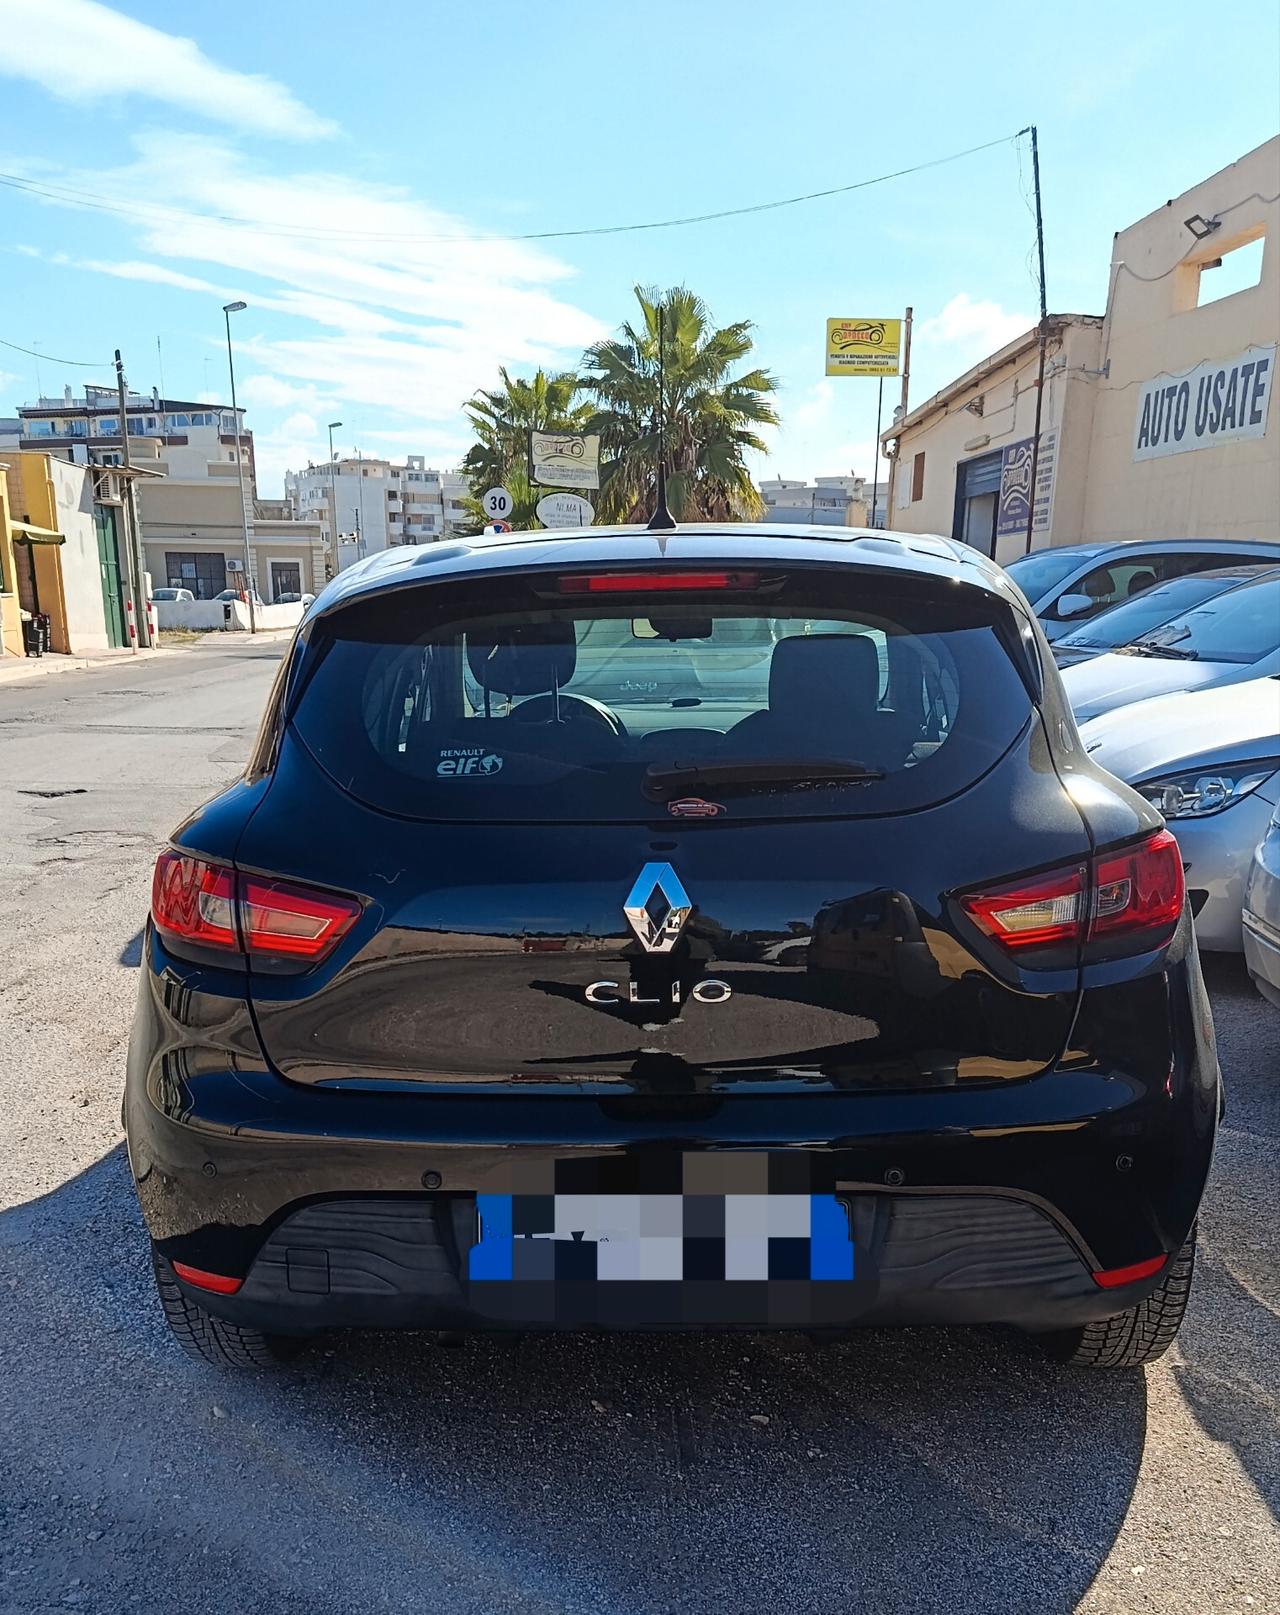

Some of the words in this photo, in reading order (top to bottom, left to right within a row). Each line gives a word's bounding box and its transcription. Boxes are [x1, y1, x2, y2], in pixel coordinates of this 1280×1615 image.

[1138, 380, 1190, 449] AUTO
[1195, 358, 1270, 437] USATE
[490, 496, 506, 511] 30
[440, 748, 485, 757] RENAULT
[437, 758, 479, 775] elf
[585, 979, 732, 1003] CLIO
